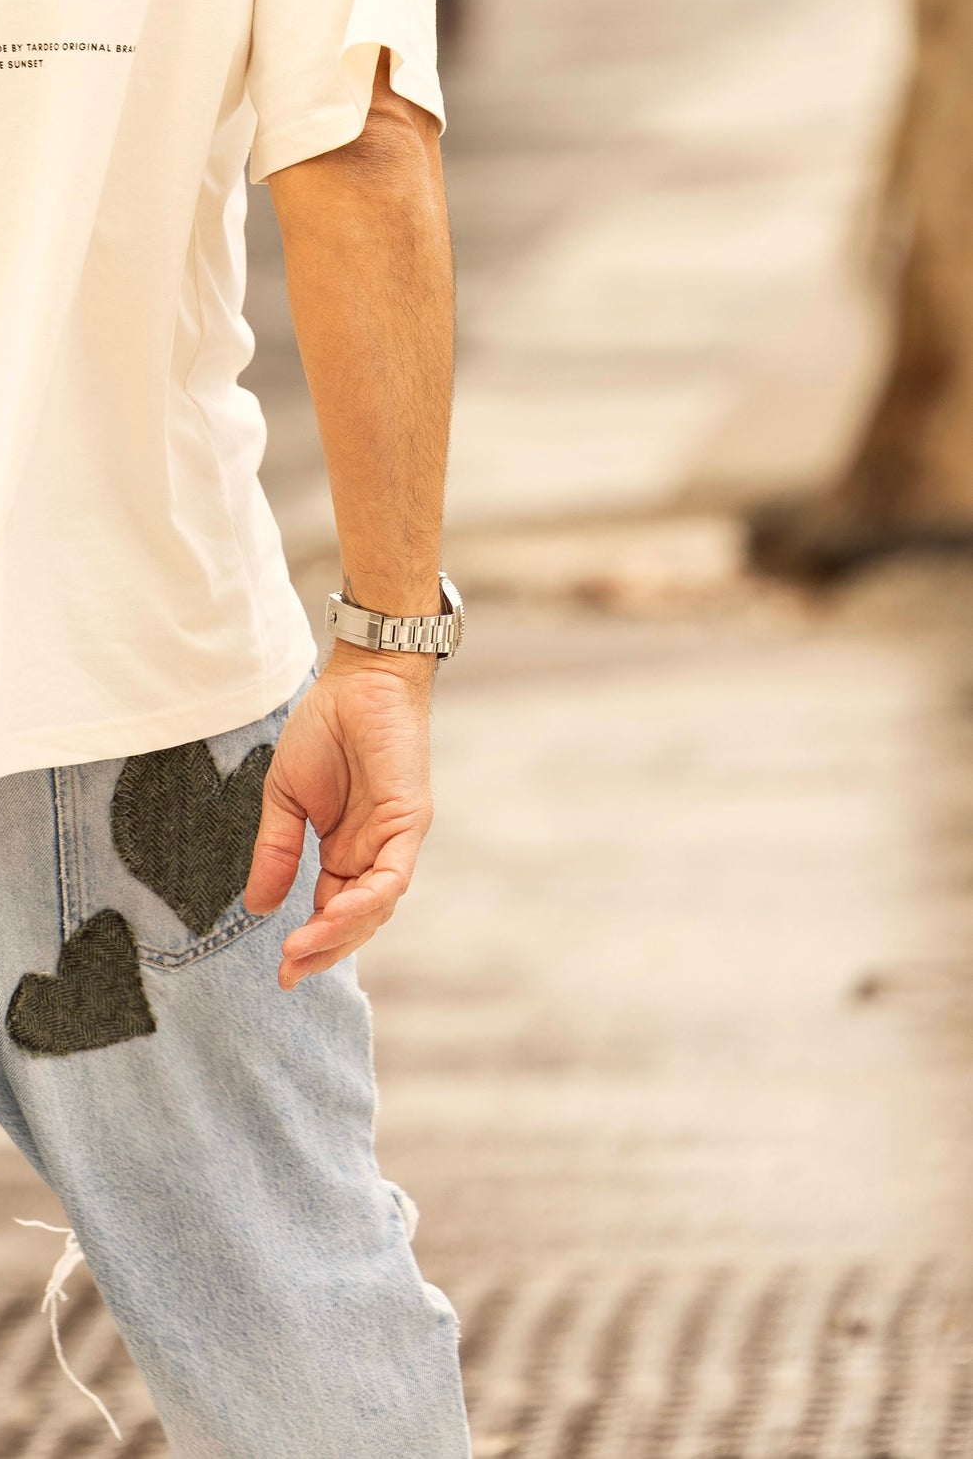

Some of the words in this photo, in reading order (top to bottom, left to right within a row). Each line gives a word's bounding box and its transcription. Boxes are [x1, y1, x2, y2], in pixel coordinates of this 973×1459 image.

[11, 43, 23, 53] BY
[26, 42, 60, 52] TARDEO
[61, 42, 112, 52] ORIGINAL
[7, 59, 44, 69] SUNSET
